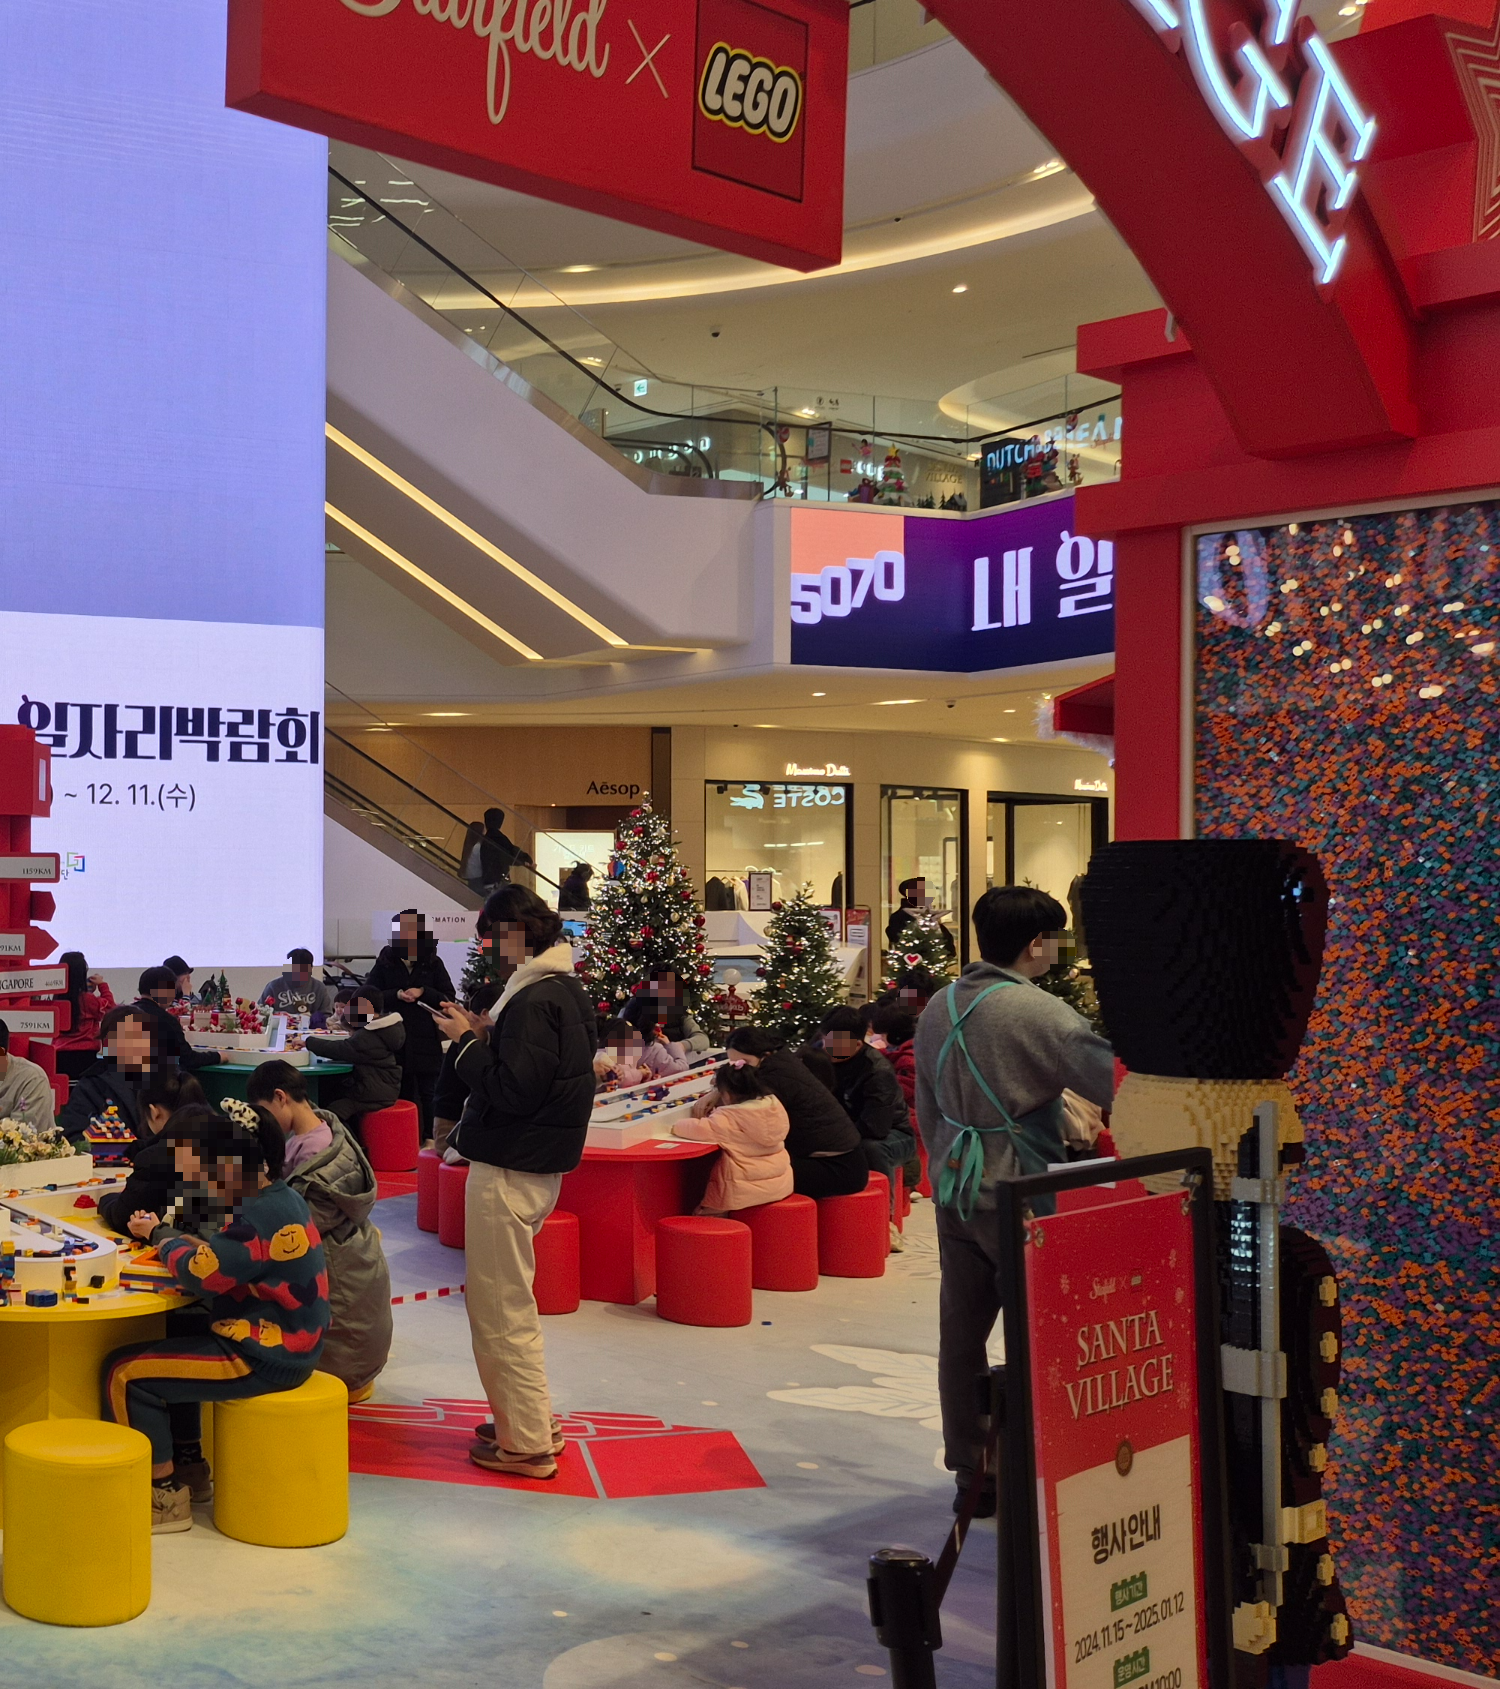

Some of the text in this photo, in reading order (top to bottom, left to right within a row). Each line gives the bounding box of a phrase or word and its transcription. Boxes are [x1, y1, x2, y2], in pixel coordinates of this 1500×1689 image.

[701, 46, 800, 140] LEGO
[790, 551, 906, 626] 5070
[971, 546, 1034, 633] 내
[17, 694, 320, 766] 일자리박람회
[432, 916, 466, 924] MATION
[1075, 1308, 1165, 1372] SANTA
[1064, 1353, 1175, 1422] VILLAGE
[1090, 1503, 1162, 1566] 행사안내
